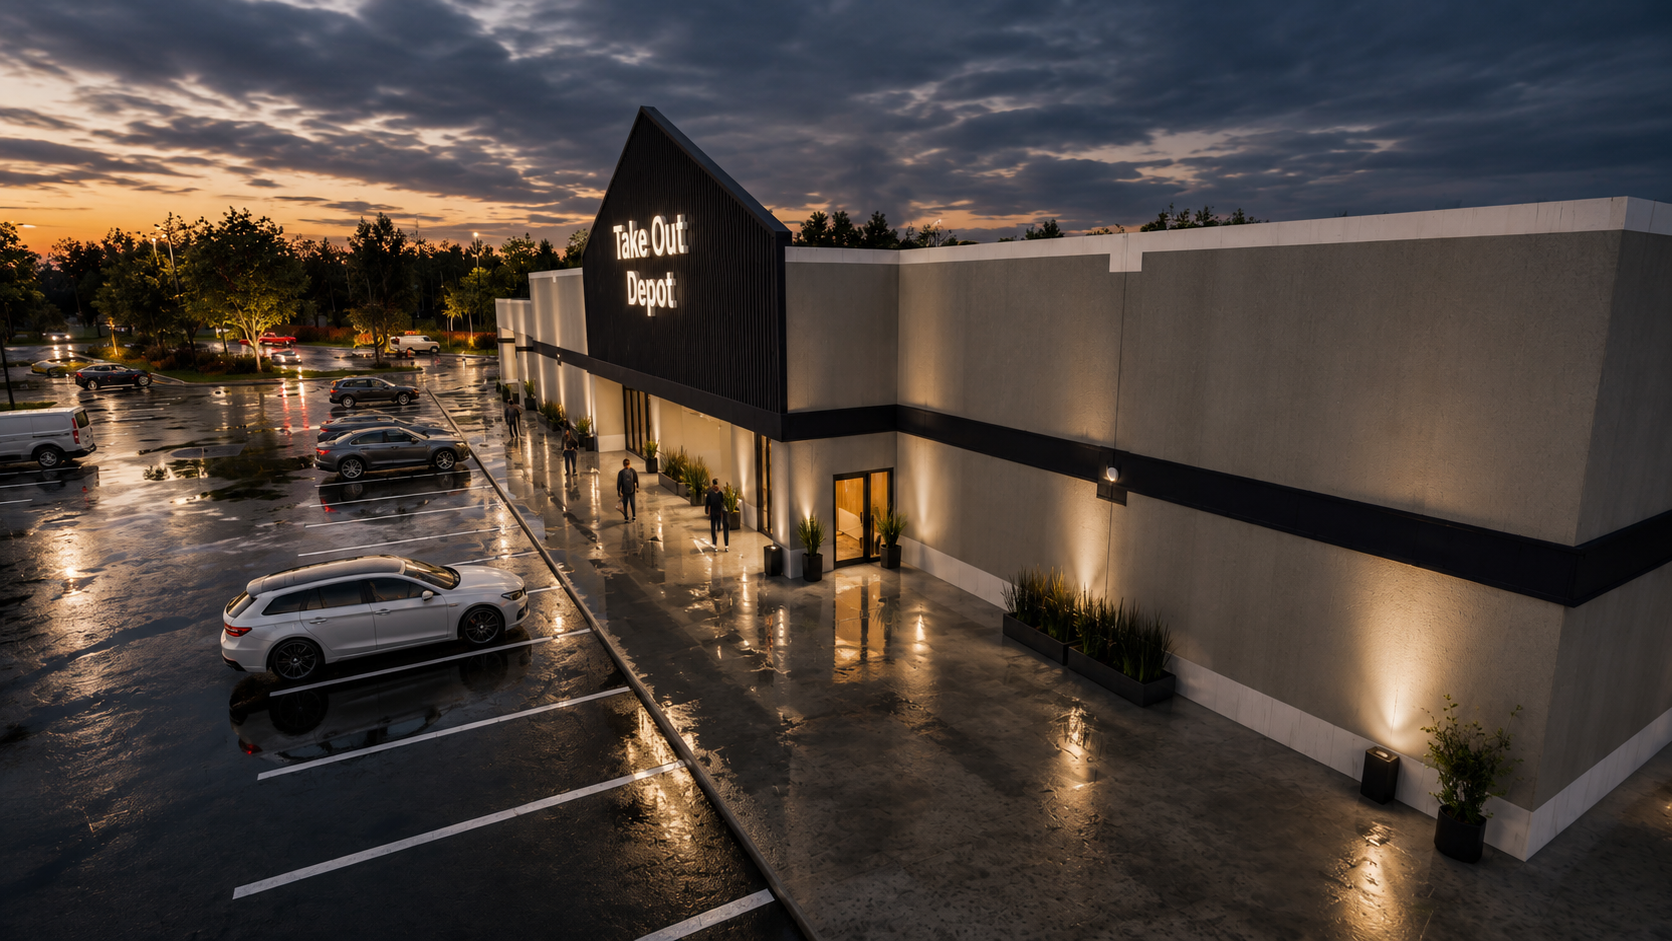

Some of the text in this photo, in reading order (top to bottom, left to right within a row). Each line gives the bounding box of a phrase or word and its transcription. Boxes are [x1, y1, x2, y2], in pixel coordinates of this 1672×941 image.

[613, 214, 688, 260] Take Out
[626, 270, 677, 317] Depot
